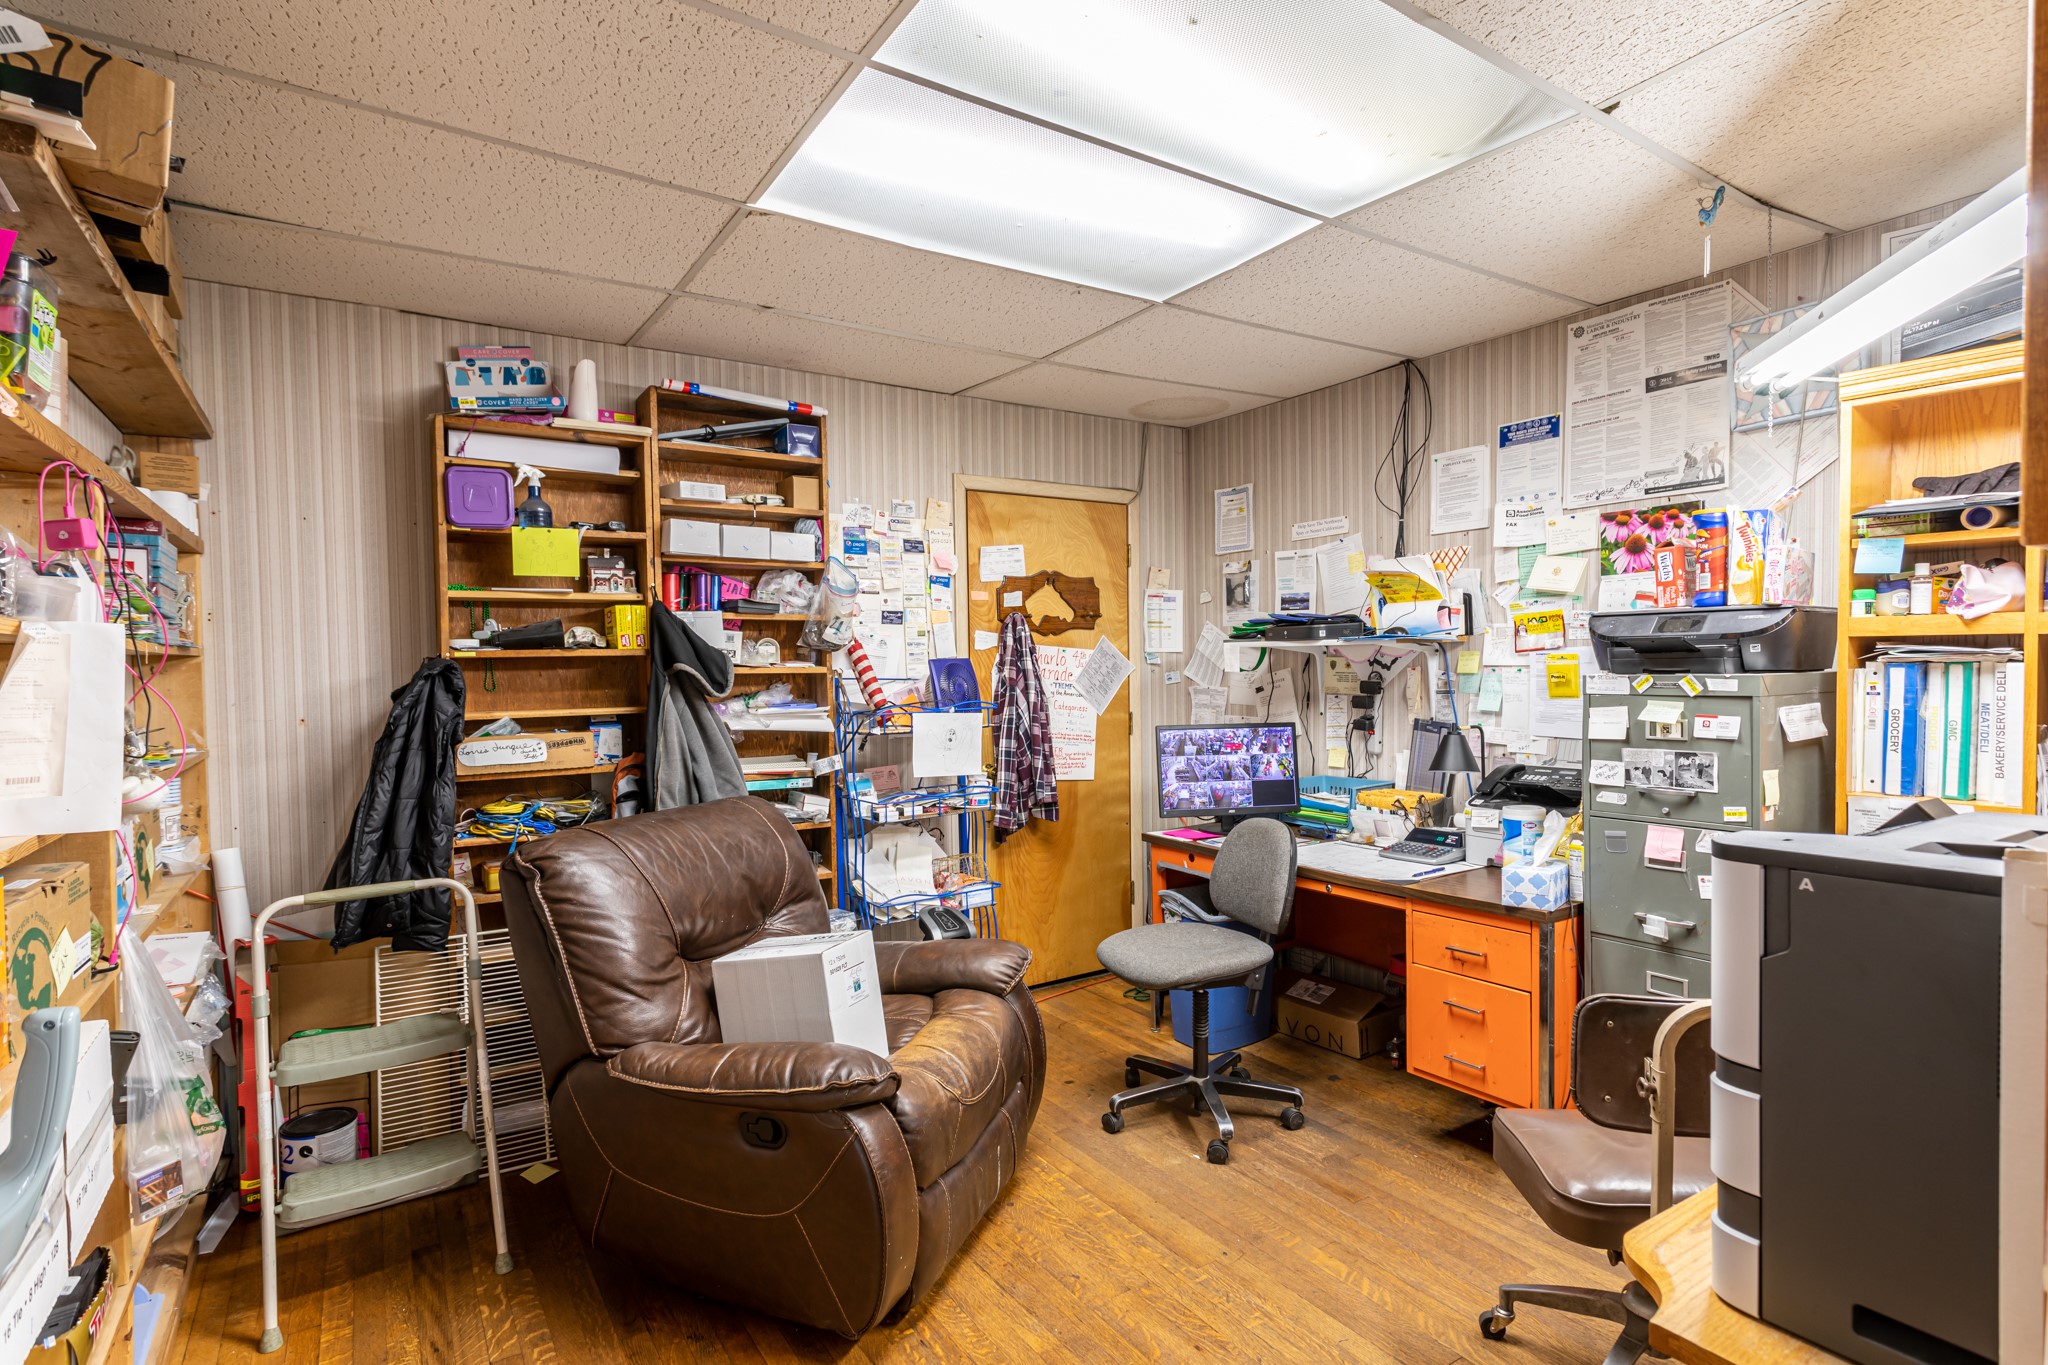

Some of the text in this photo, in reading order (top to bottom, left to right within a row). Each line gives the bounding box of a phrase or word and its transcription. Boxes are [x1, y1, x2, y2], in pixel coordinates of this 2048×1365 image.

[1586, 325, 1605, 335] LABOR
[1611, 313, 1641, 328] INDUSTRY
[1604, 314, 1627, 324] Department
[1707, 363, 1722, 371] Health
[1516, 506, 1543, 514] Associated
[1736, 522, 1758, 563] Twinkies
[1658, 553, 1672, 581] Welch's
[1036, 647, 1066, 666] harlo
[1040, 666, 1073, 682] arade
[1054, 700, 1088, 714] Categories:
[1890, 708, 1900, 754] GROCERY
[1928, 705, 1938, 751] PRODUCE
[1948, 720, 1958, 742] GMC
[1980, 702, 1991, 753] MEAT/DELI
[1994, 670, 2006, 779] BAKERY/SERVICE DELI
[548, 737, 584, 749] WHOPPERS
[1798, 878, 1814, 892] A
[282, 1145, 294, 1164] 2
[4, 1322, 11, 1344] 16
[13, 1308, 22, 1328] Tie
[34, 1266, 46, 1294] High
